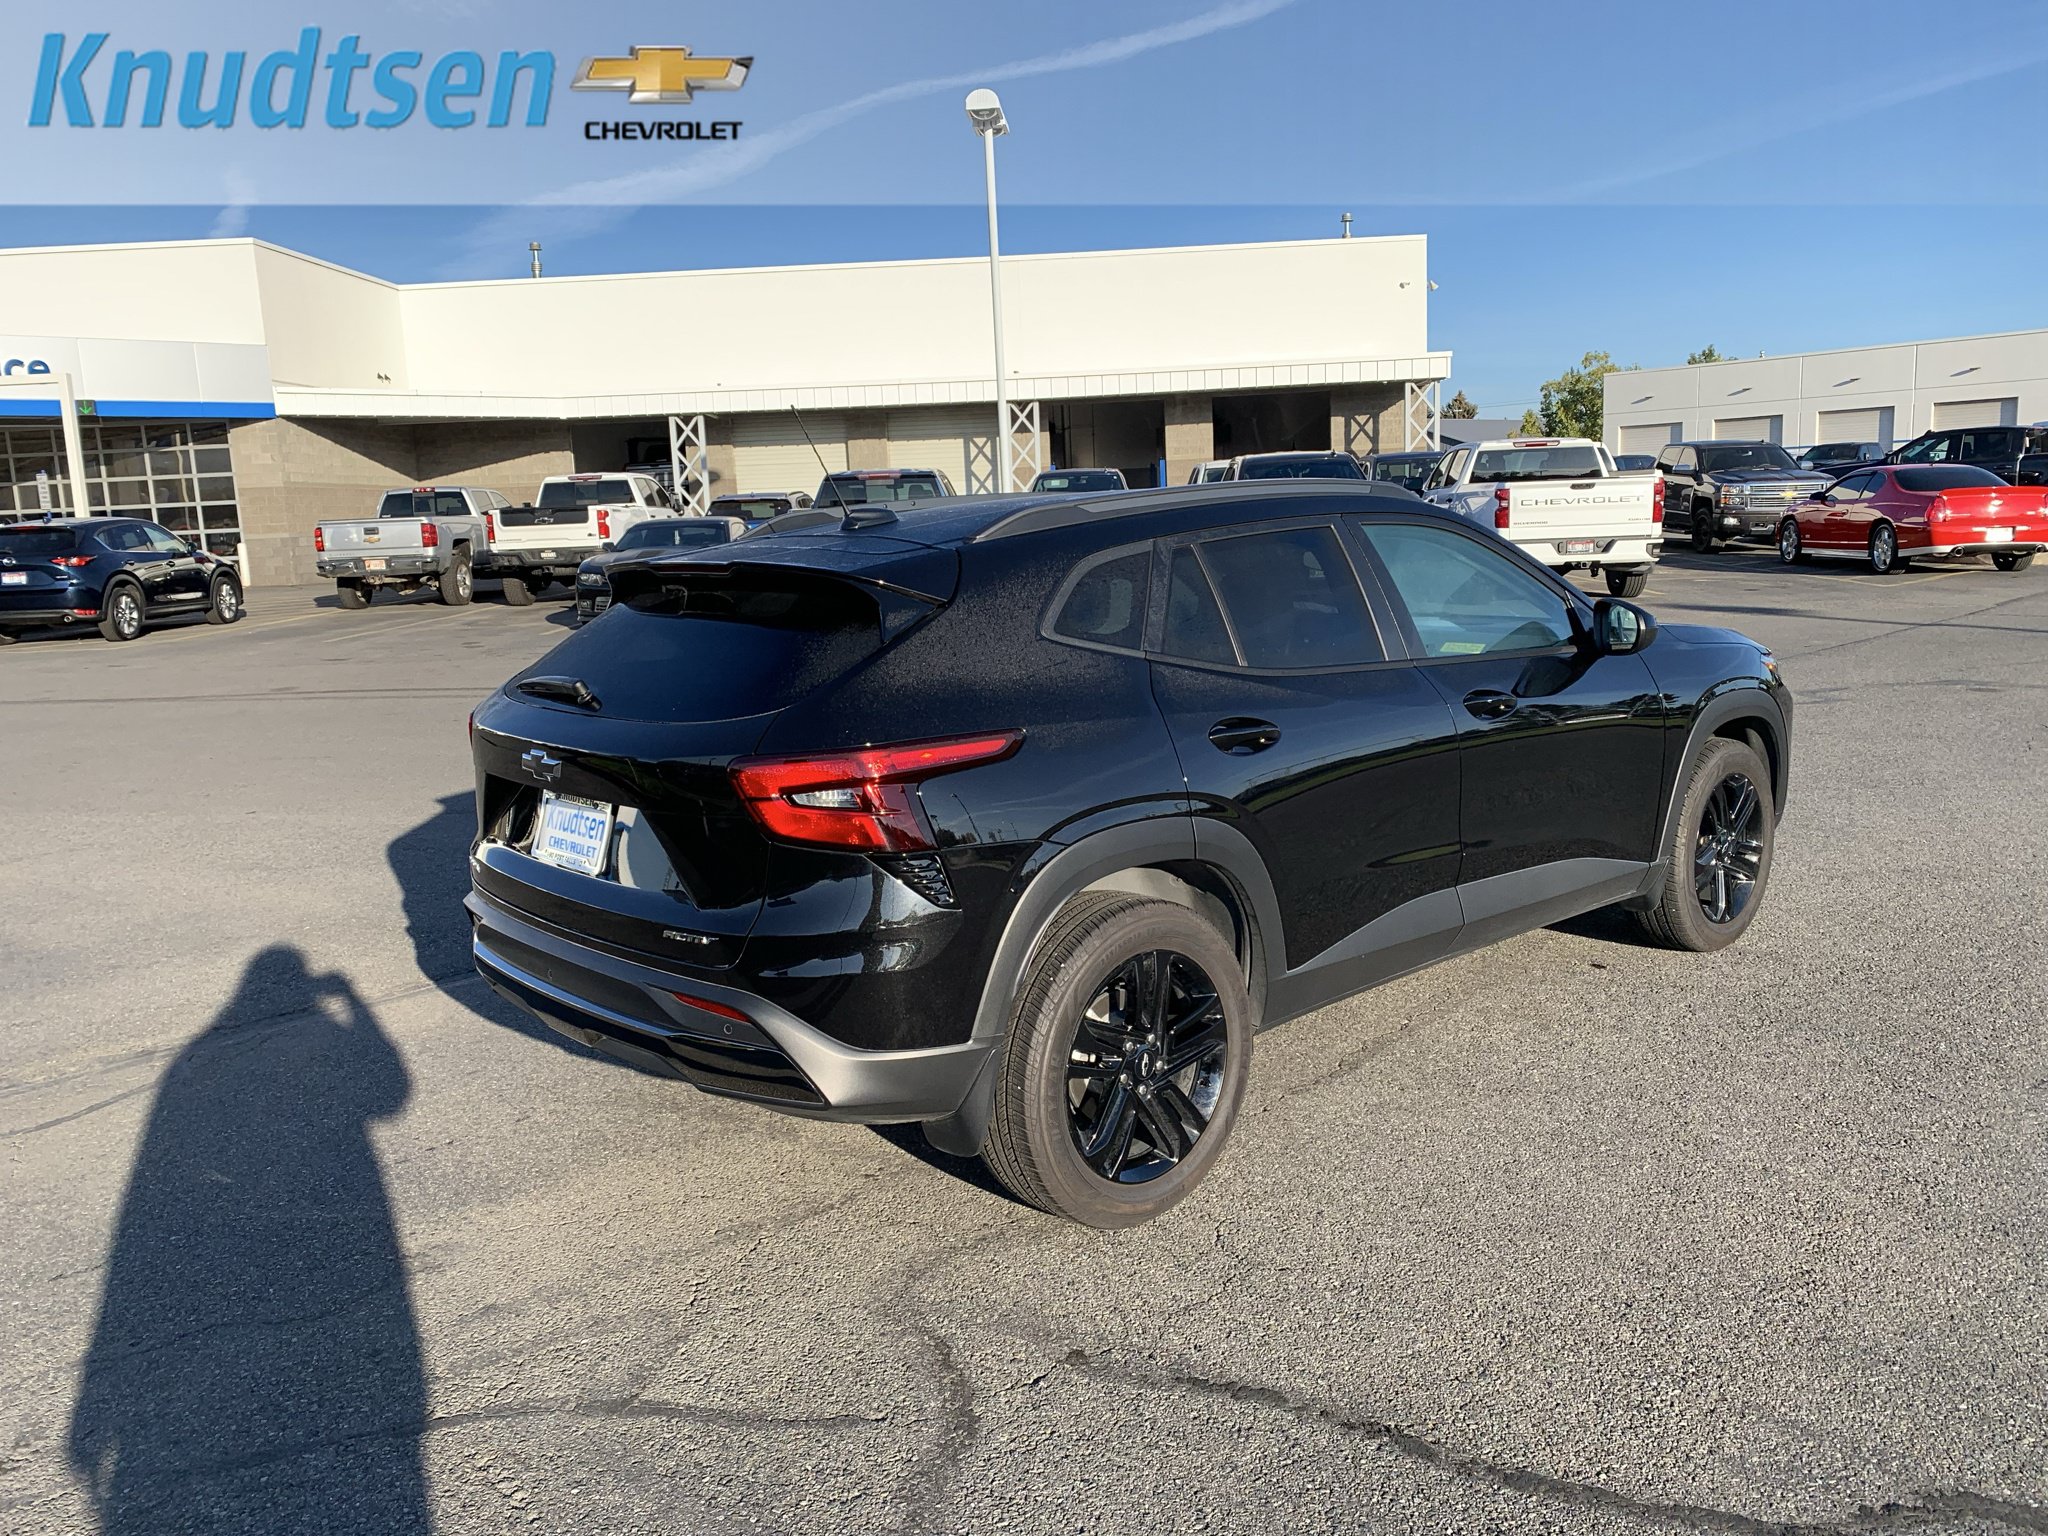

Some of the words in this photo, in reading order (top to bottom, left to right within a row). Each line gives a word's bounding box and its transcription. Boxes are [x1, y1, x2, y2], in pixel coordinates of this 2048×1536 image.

[1520, 495, 1645, 507] CHEVROLET
[547, 806, 606, 842] Knudtsen
[548, 835, 597, 859] CHEVROLET
